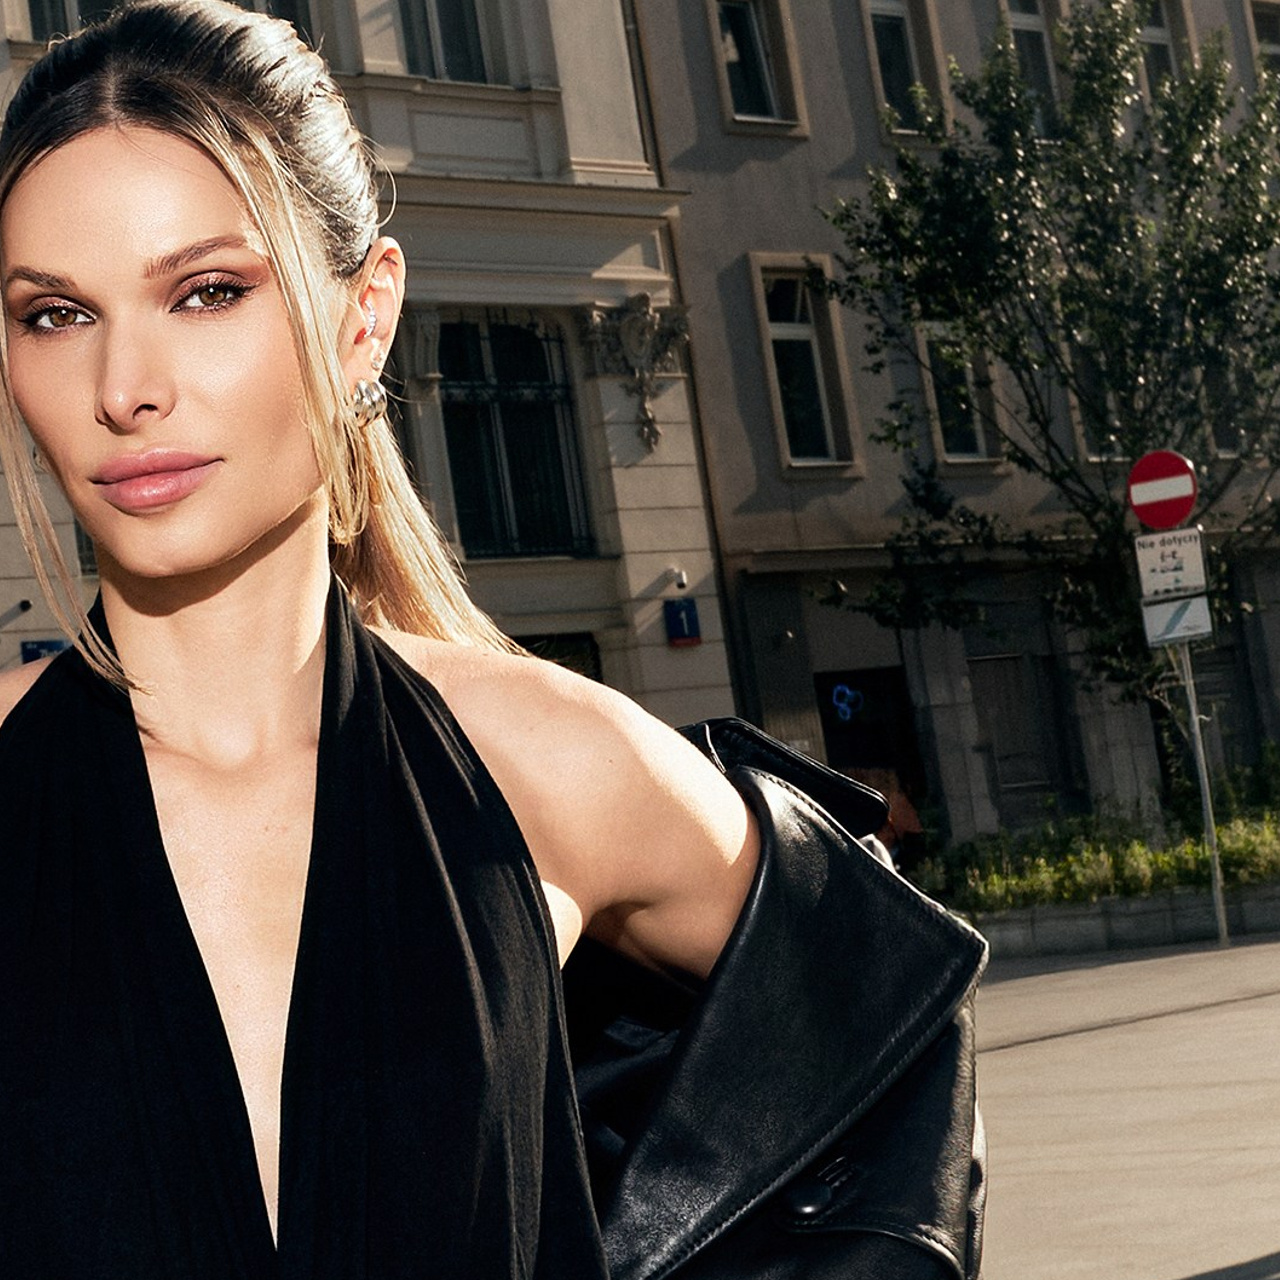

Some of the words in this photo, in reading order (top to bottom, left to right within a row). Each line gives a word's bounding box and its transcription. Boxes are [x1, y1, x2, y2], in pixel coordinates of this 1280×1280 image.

[1137, 540, 1155, 550] Nie
[1159, 534, 1198, 547] dotyczy
[679, 610, 688, 635] 1
